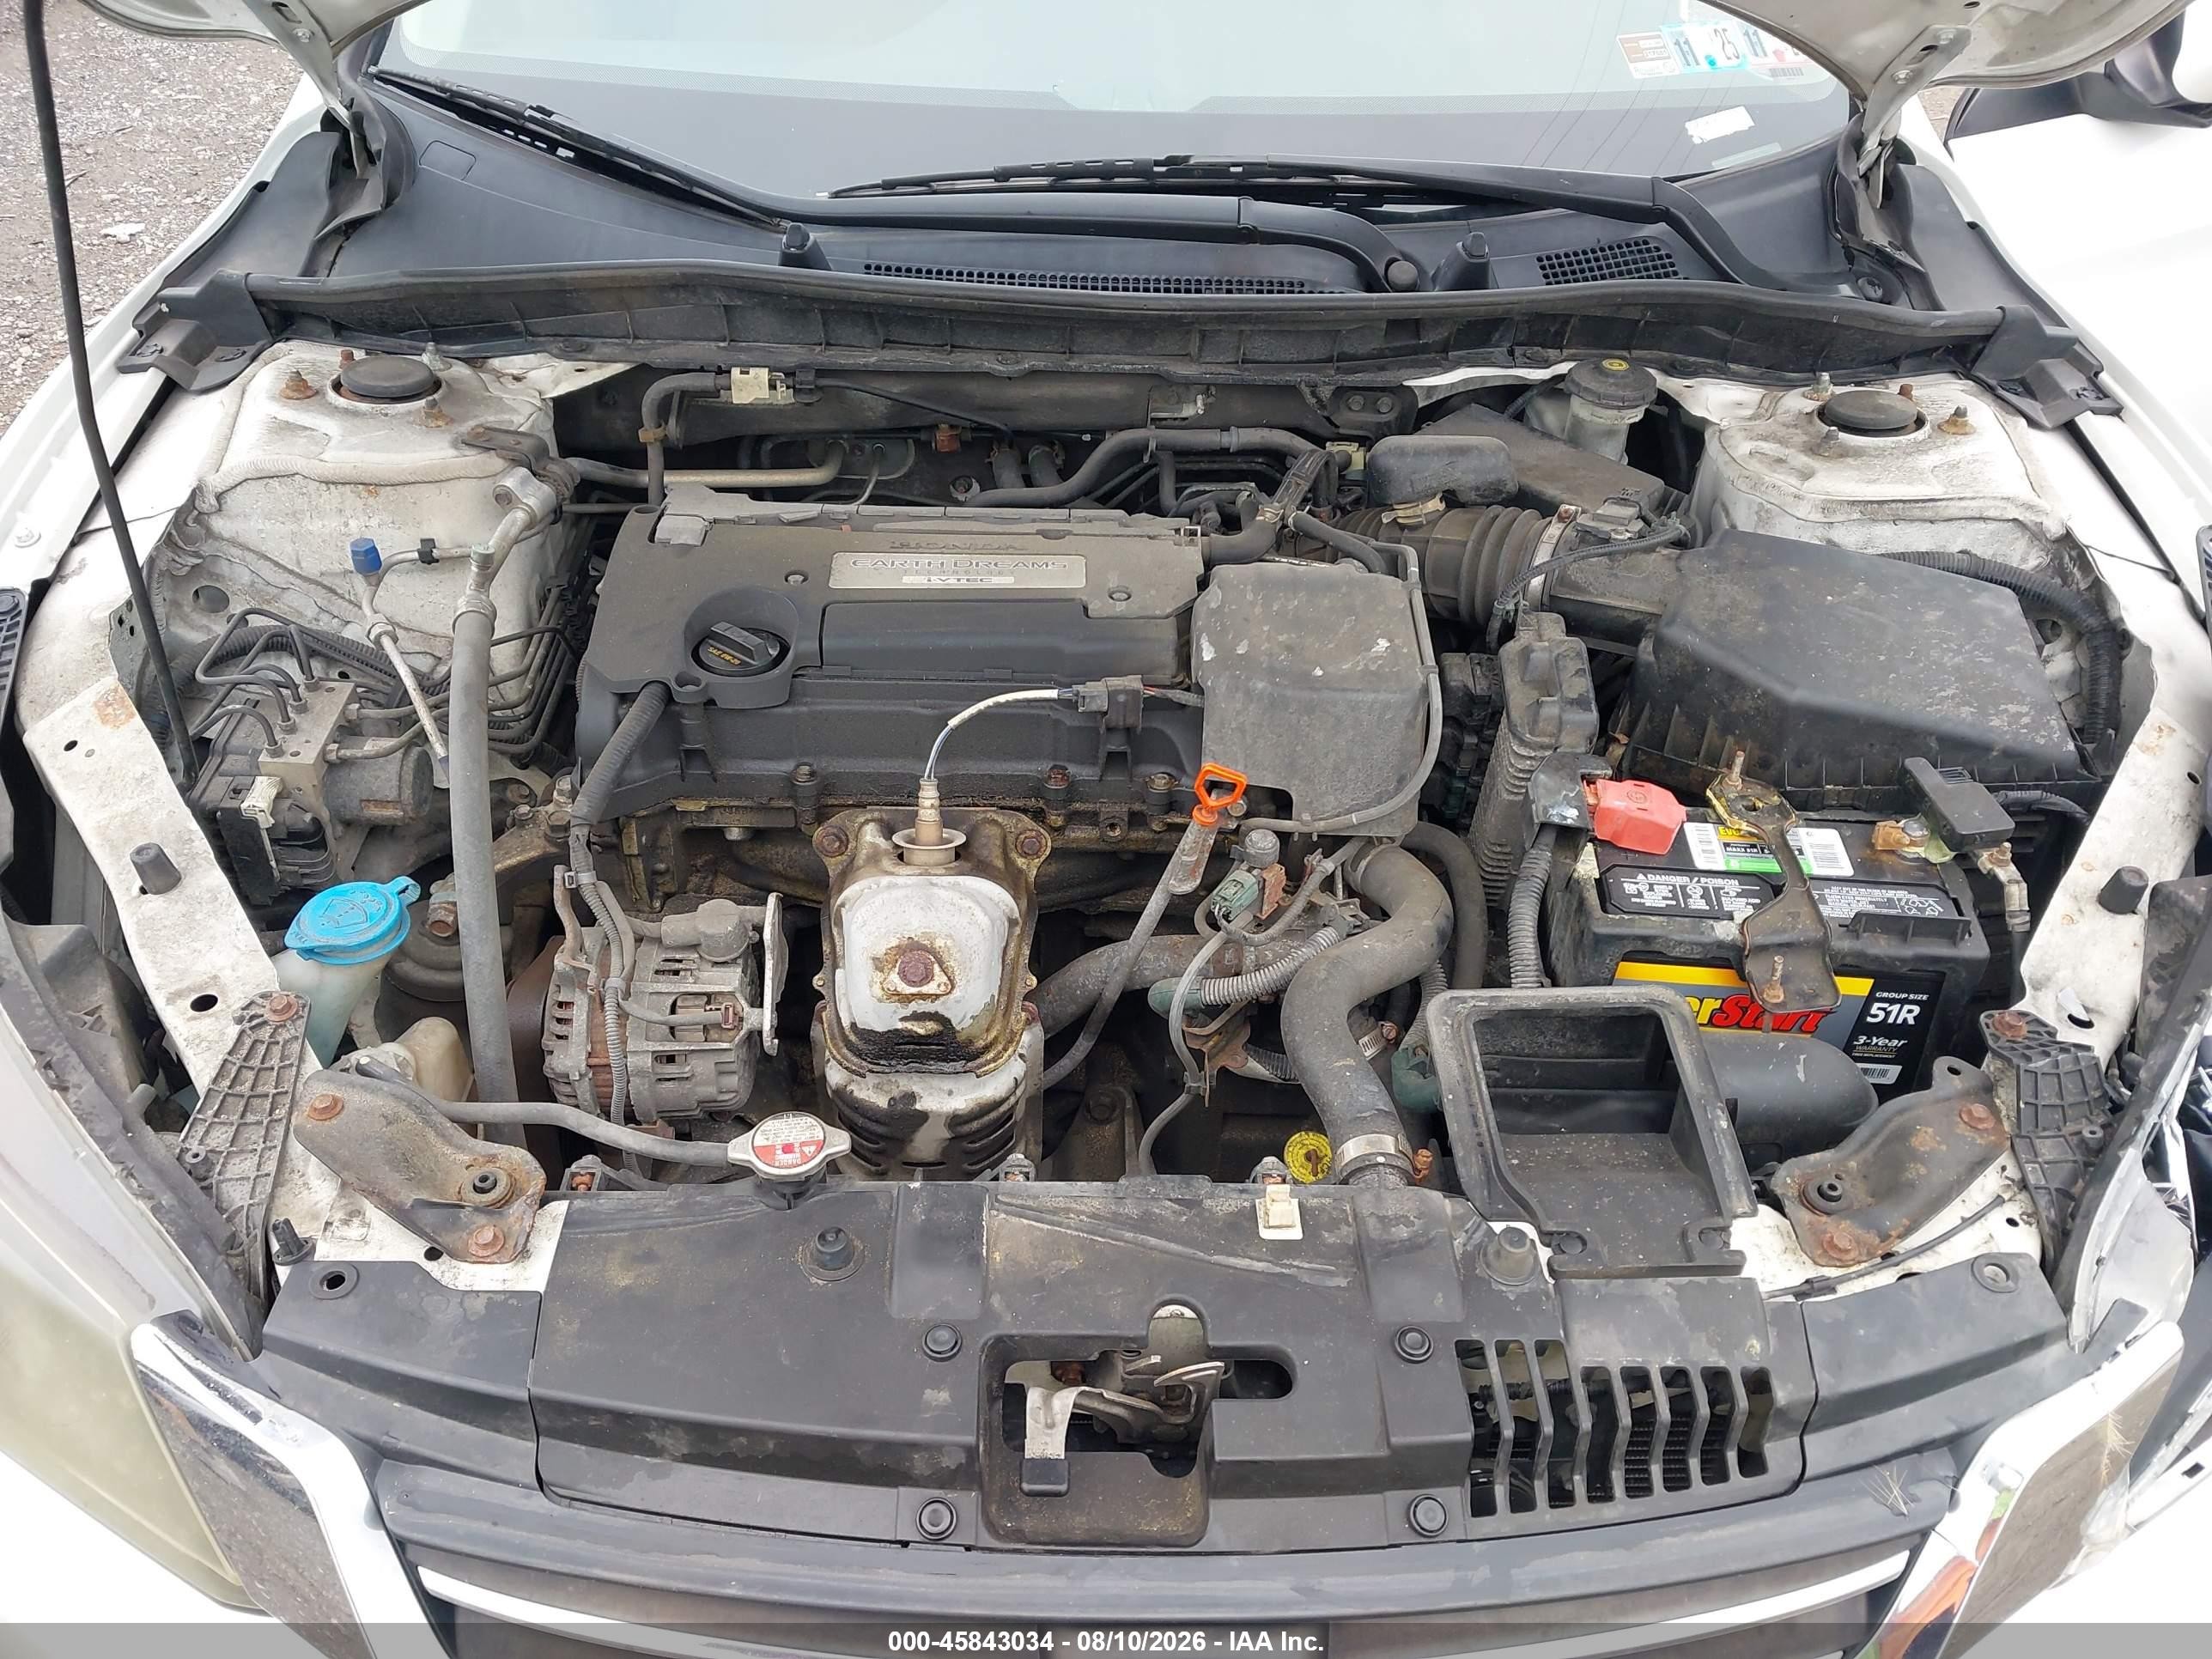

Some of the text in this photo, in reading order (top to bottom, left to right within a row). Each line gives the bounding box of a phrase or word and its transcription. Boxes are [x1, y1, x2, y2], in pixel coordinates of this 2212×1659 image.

[1674, 38, 1700, 66] 11
[851, 558, 945, 570] EARTH
[1647, 874, 1691, 884] DANGER
[1701, 878, 1740, 886] POISON
[1866, 1002, 1921, 1025] 51R
[1853, 1036, 1908, 1047] 3-Year
